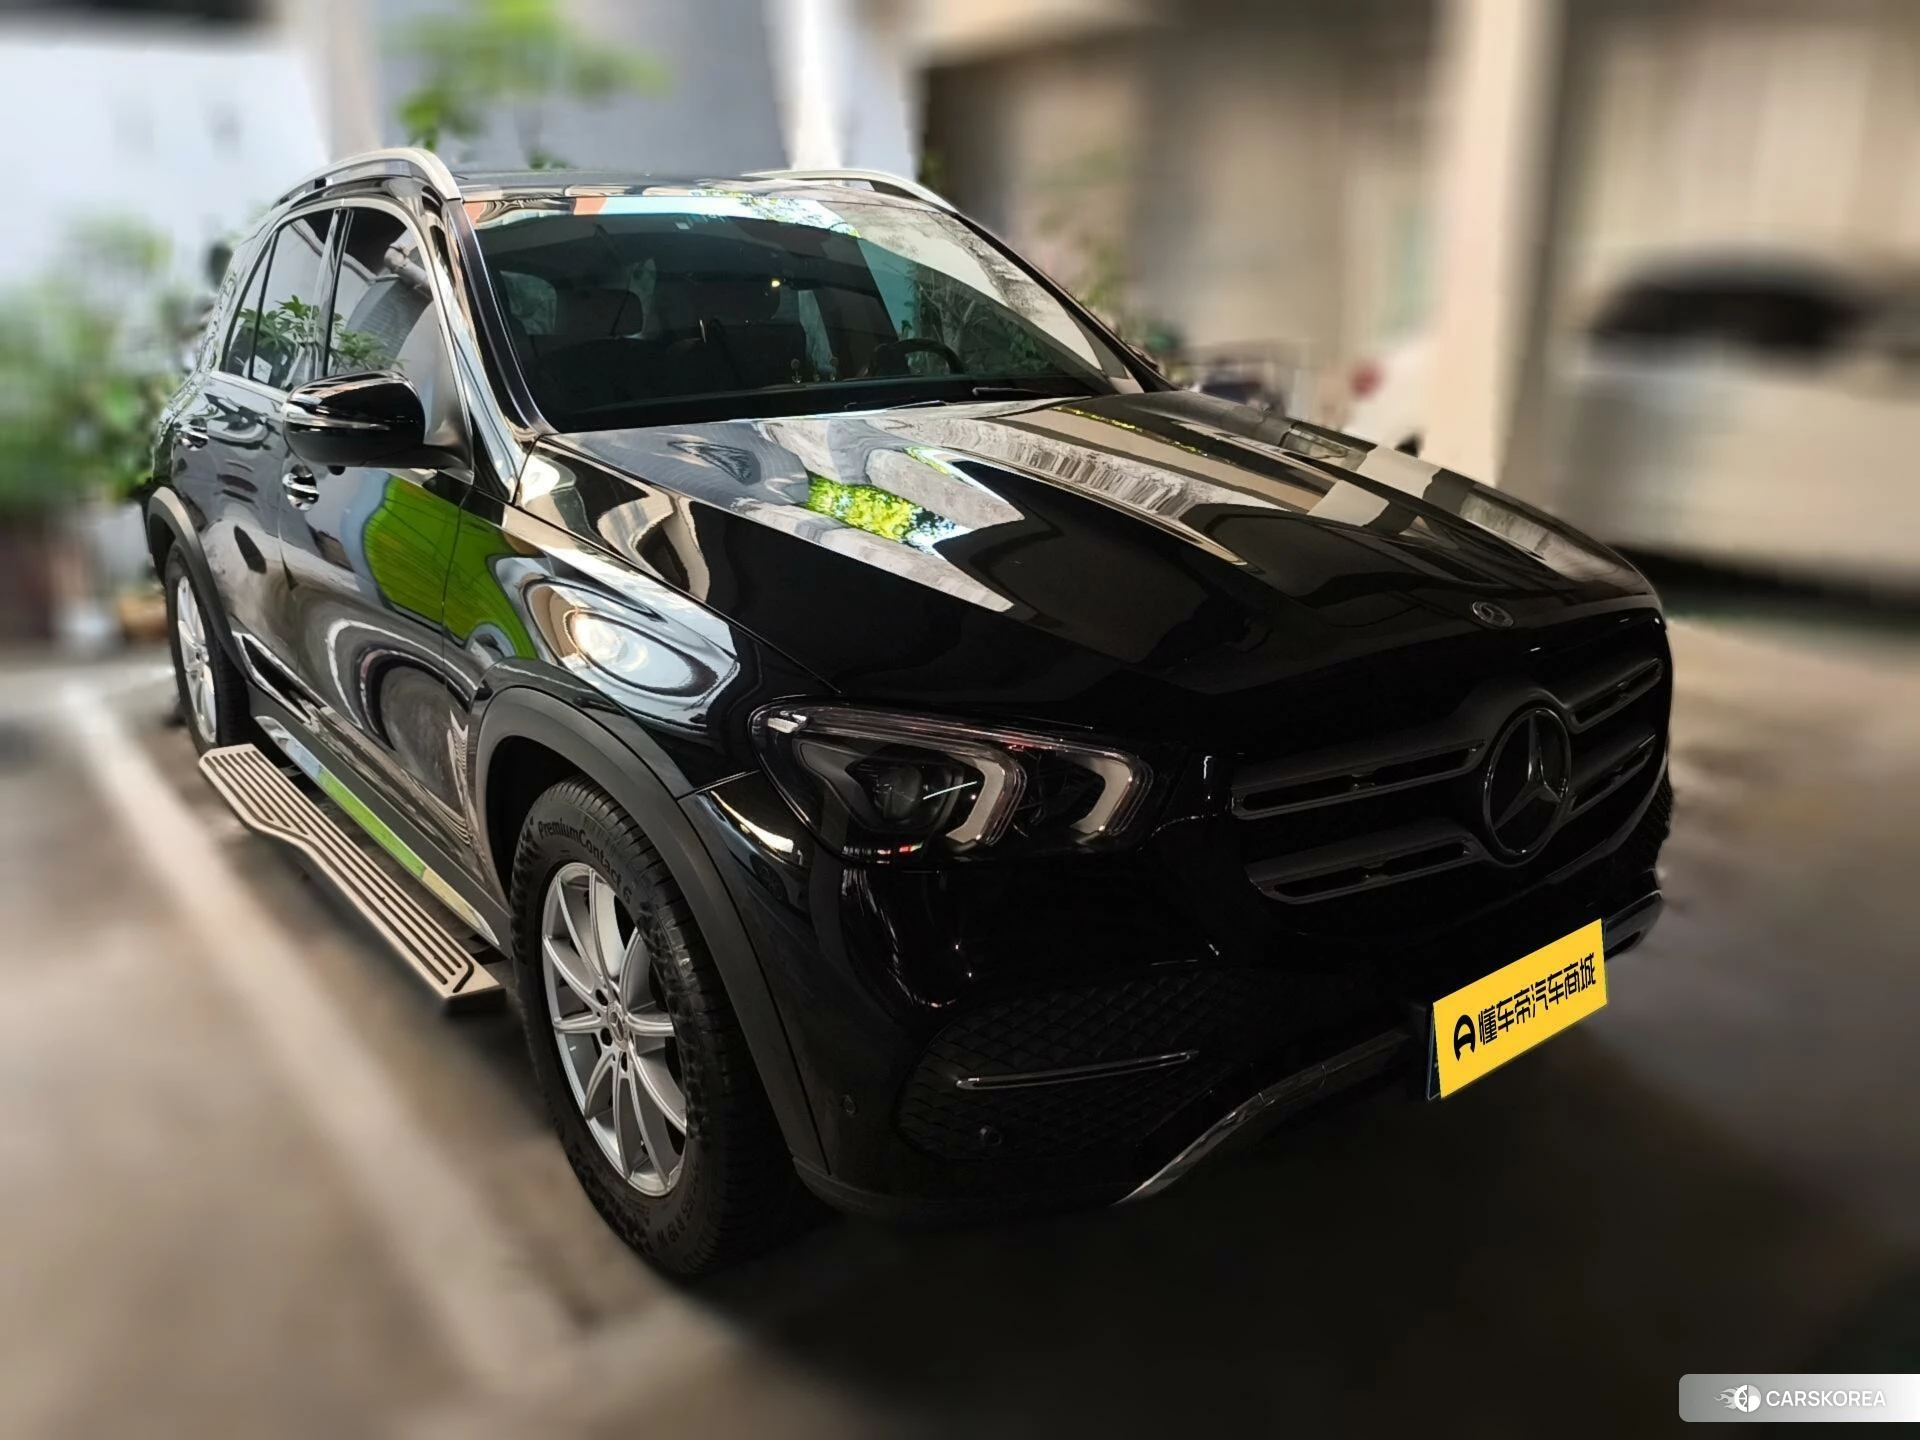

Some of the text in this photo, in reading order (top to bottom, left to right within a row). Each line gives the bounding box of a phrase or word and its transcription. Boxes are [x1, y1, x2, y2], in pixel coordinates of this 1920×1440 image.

[538, 816, 622, 888] PremiumContact
[1477, 952, 1597, 1046] 懂车帝汽车商城
